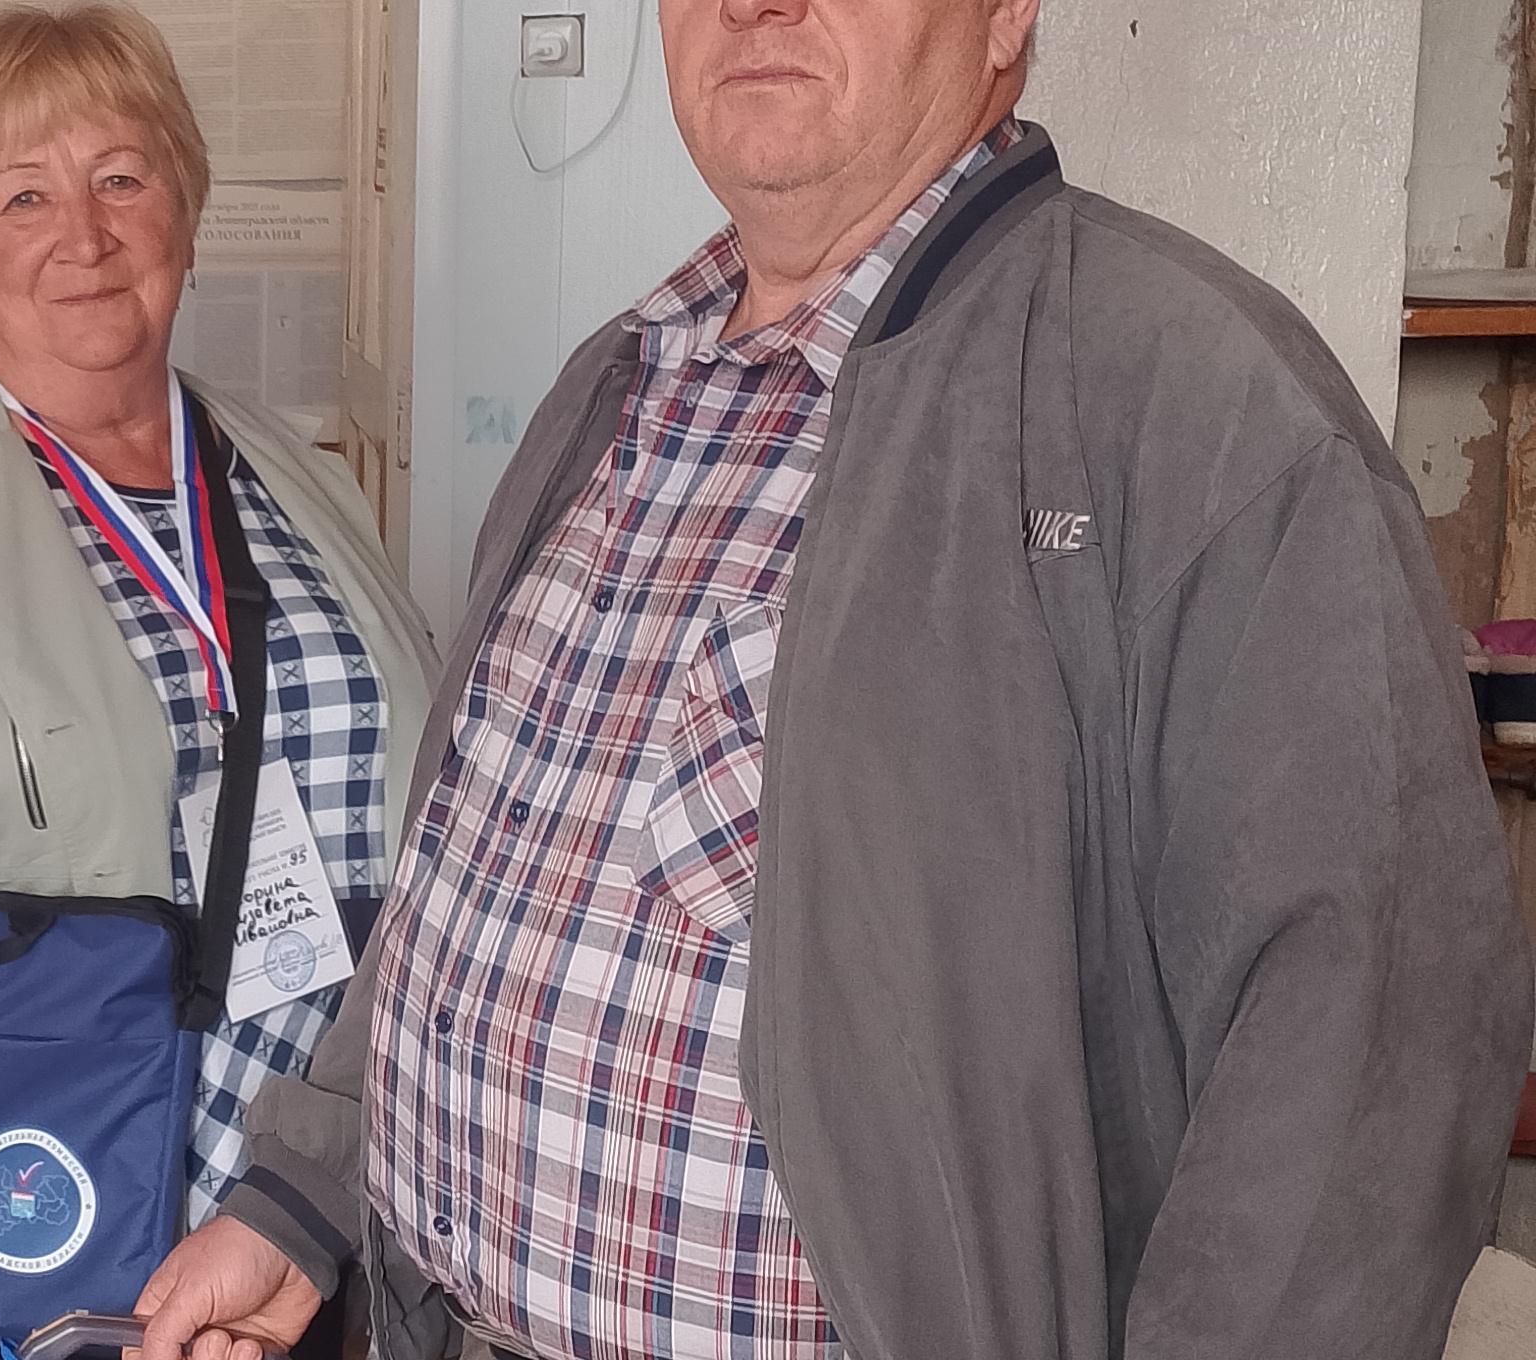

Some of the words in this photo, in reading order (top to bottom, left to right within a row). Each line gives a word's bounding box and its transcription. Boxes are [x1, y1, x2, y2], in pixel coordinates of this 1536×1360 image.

[203, 228, 301, 241] ОЛОСОВАНИЯ
[239, 891, 313, 926] изавета
[243, 876, 302, 907] орина
[46, 1138, 89, 1186] КОМИССИЯ
[46, 1231, 85, 1267] ОБЛАСТИ
